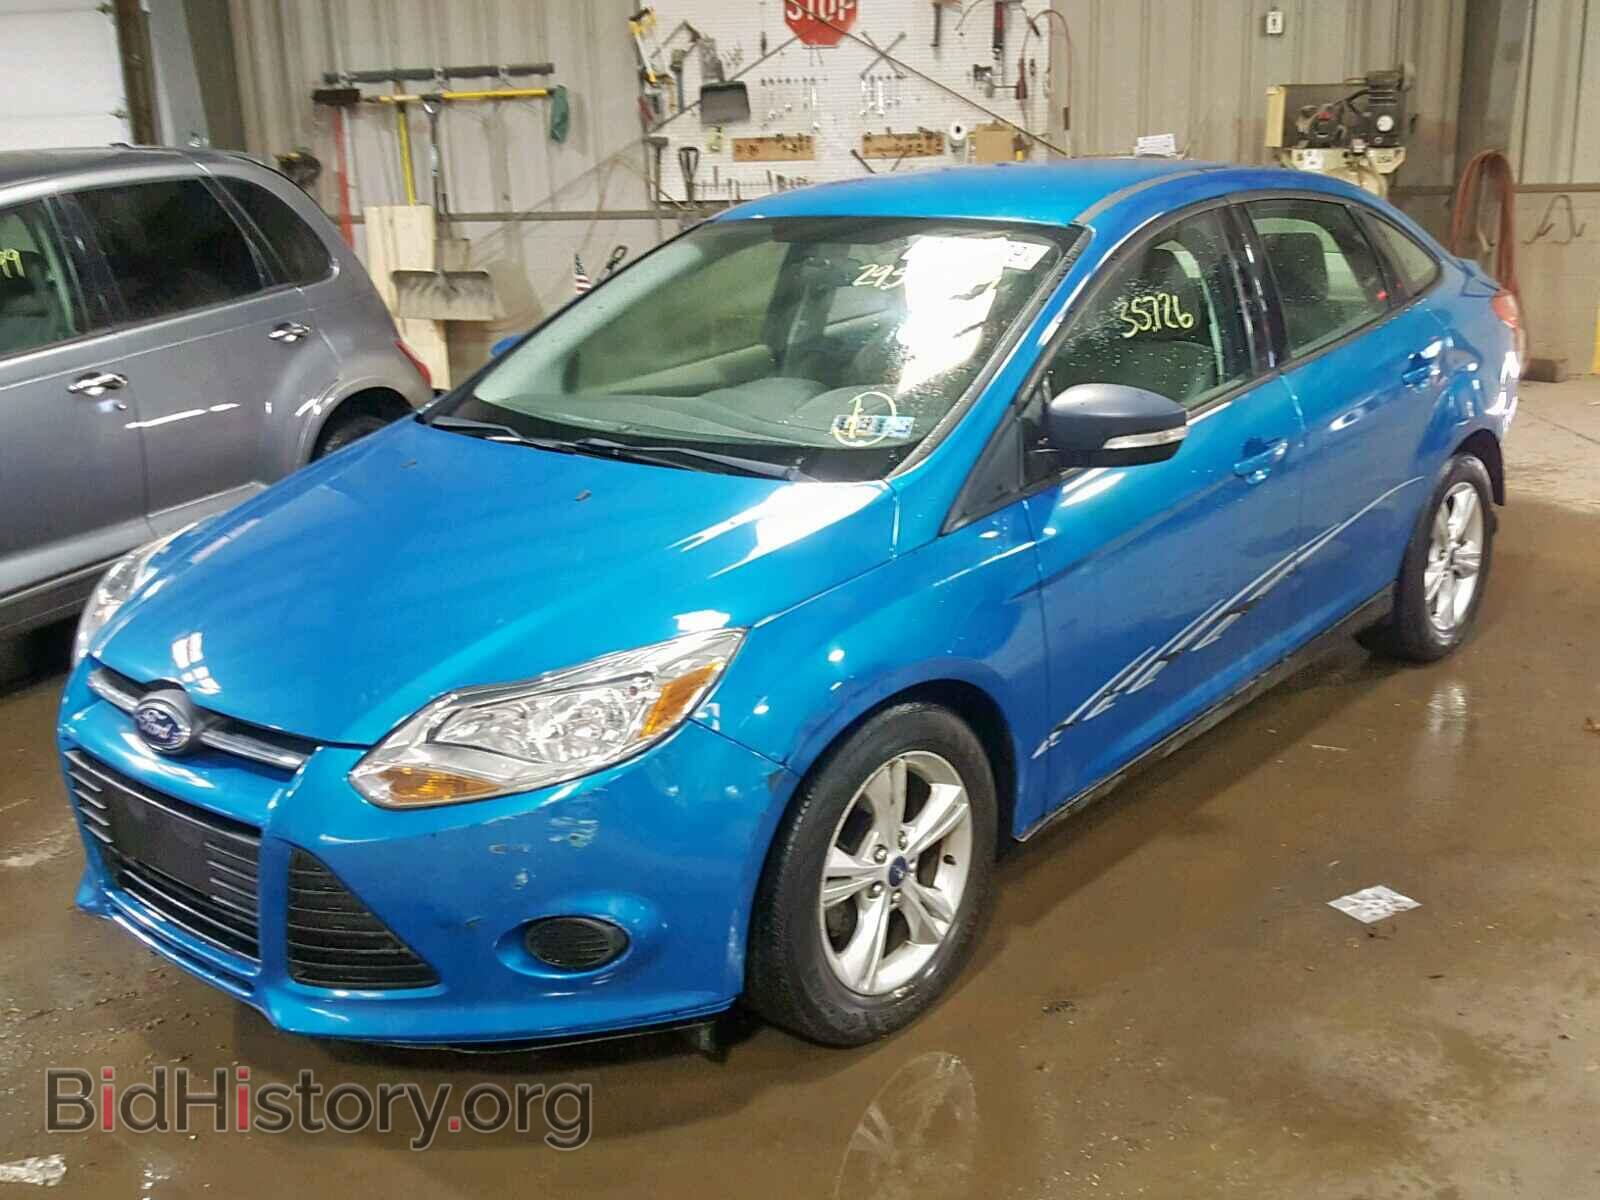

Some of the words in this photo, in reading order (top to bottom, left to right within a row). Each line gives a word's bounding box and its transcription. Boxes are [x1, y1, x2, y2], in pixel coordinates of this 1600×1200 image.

[786, 0, 855, 21] STOP
[1118, 292, 1194, 338] 35726
[137, 707, 174, 741] Ford
